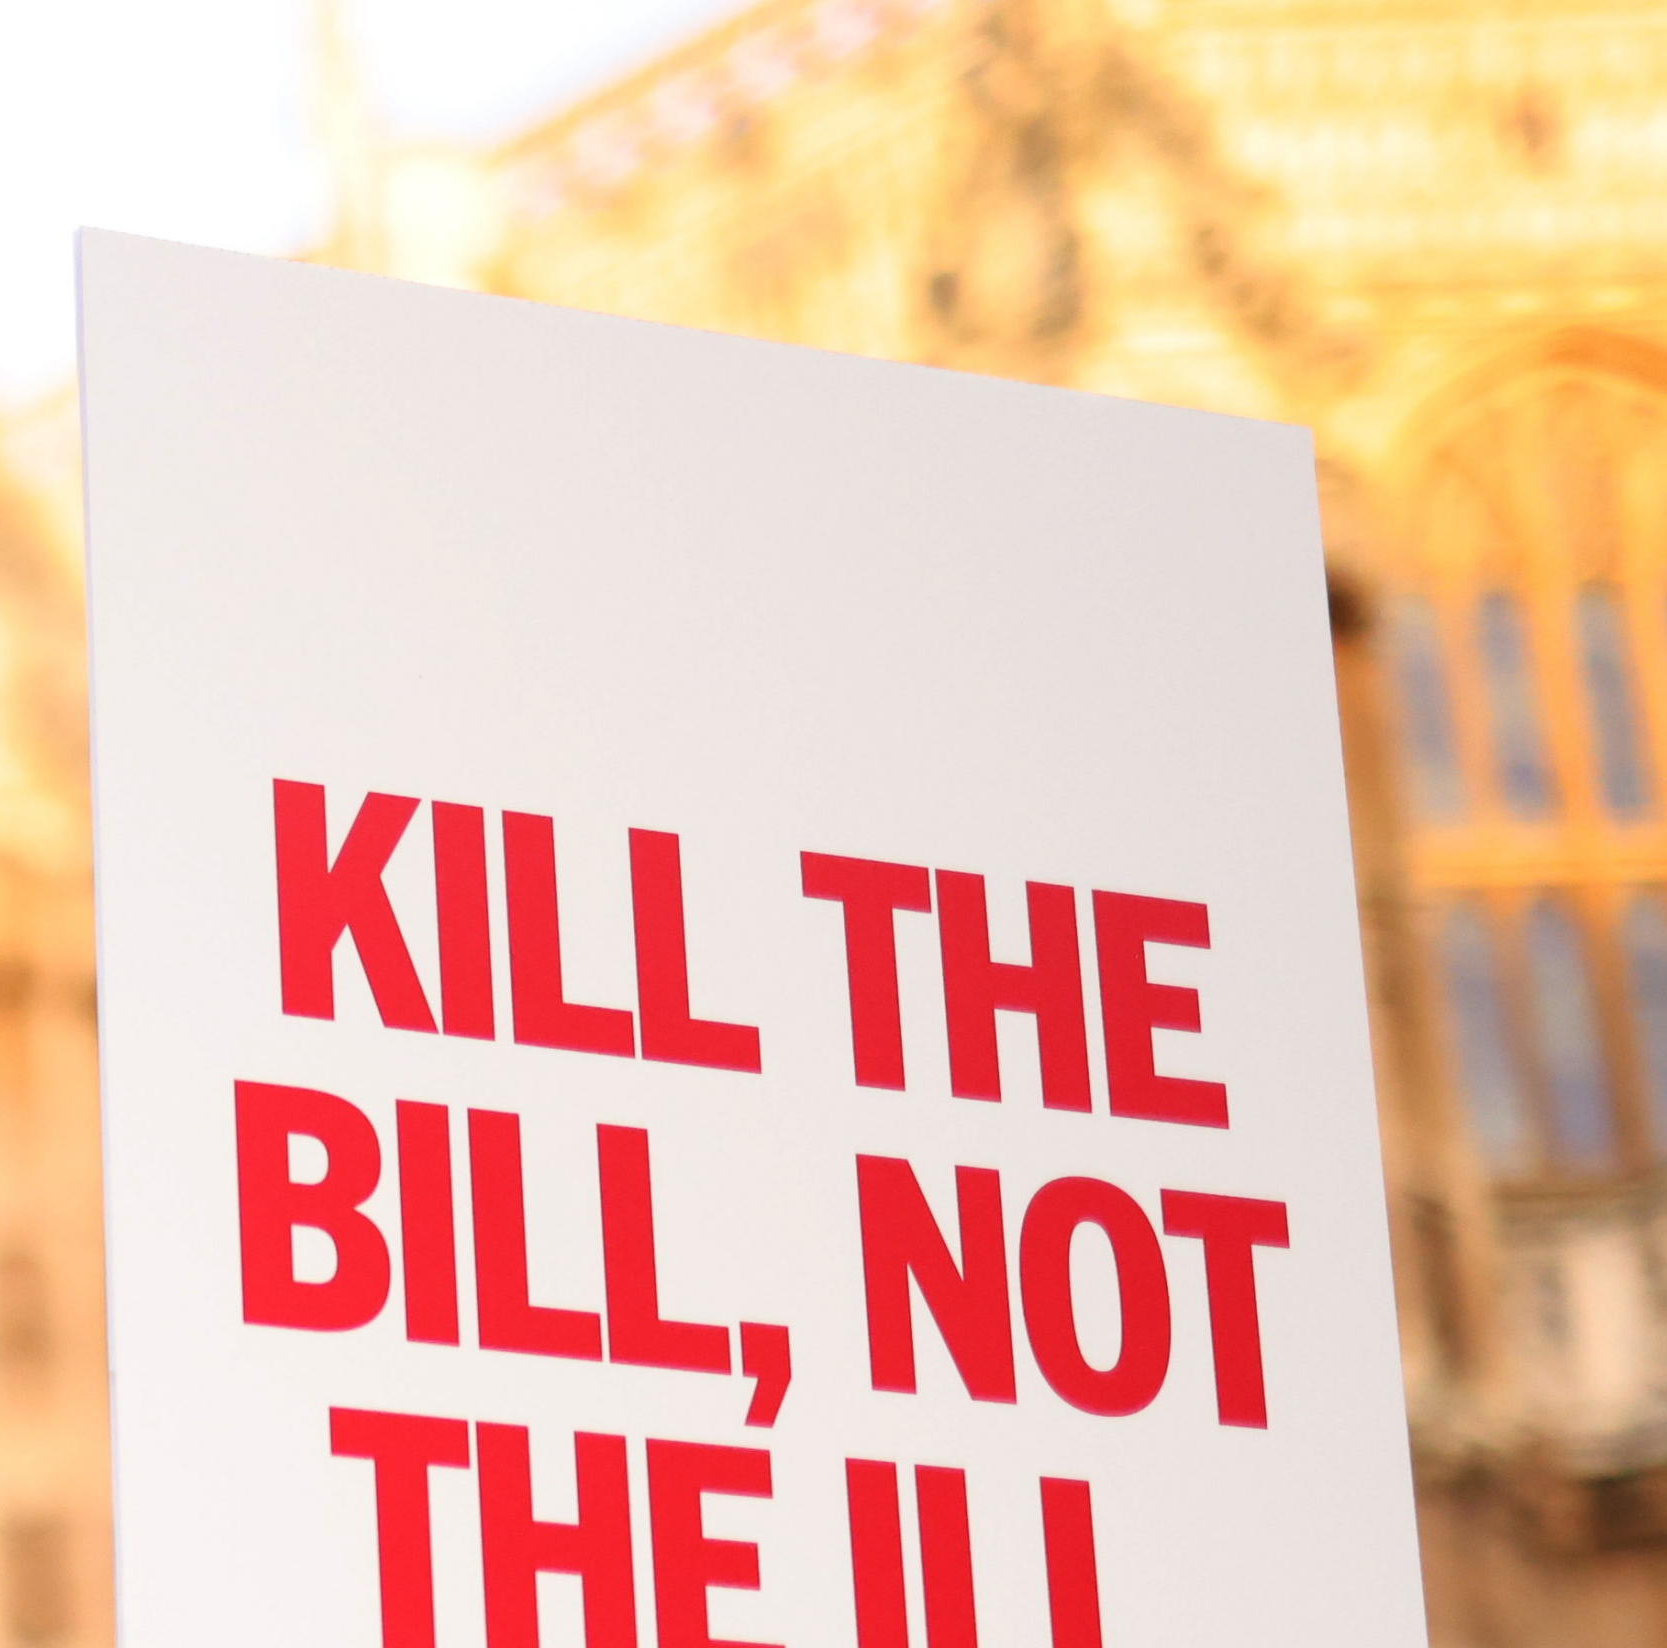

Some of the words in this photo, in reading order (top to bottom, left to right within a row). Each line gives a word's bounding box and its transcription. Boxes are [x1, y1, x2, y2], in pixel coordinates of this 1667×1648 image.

[272, 777, 763, 1074] KILL
[799, 850, 1230, 1129] THE
[233, 1079, 792, 1429] BILL,
[855, 1153, 1289, 1430] NOT
